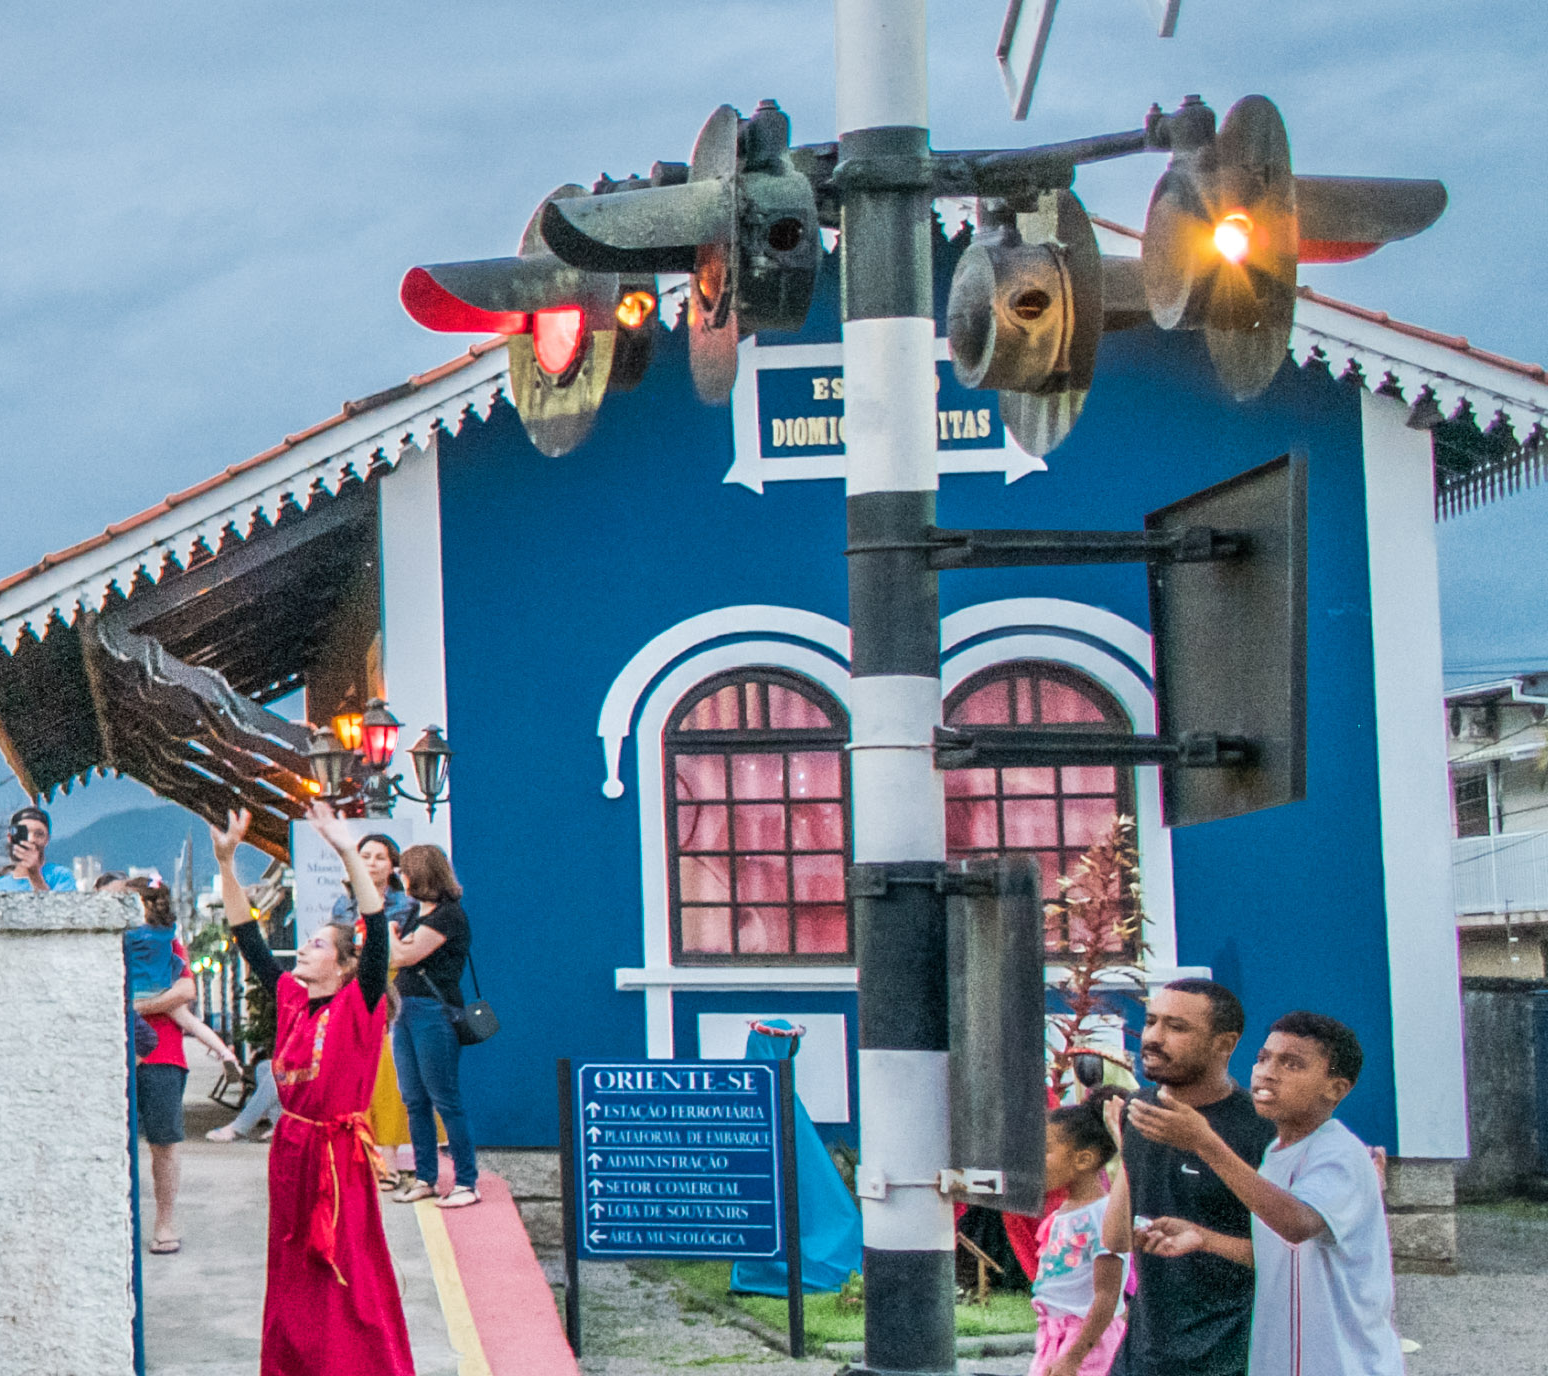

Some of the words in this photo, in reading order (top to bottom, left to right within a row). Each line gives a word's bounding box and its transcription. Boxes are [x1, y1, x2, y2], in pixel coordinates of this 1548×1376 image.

[594, 1071, 757, 1090] ORIENTE-SE
[604, 1101, 667, 1121] ESTAÇÃO
[671, 1101, 764, 1119] FERROVIÁRIA
[604, 1130, 681, 1143] PLATAFORMA
[687, 1130, 702, 1144] DE
[706, 1131, 771, 1146] EMBARQUE
[606, 1152, 729, 1172] ADMINISTRAÇÃO
[606, 1180, 652, 1194] SETOR
[656, 1181, 742, 1196] COMERCIAL
[608, 1204, 640, 1218] LOJA
[644, 1204, 662, 1218] DE
[667, 1205, 748, 1219] SOUVENIRS
[609, 1228, 644, 1243] ÁREA
[647, 1229, 746, 1245] MUSEOLÓGICA
